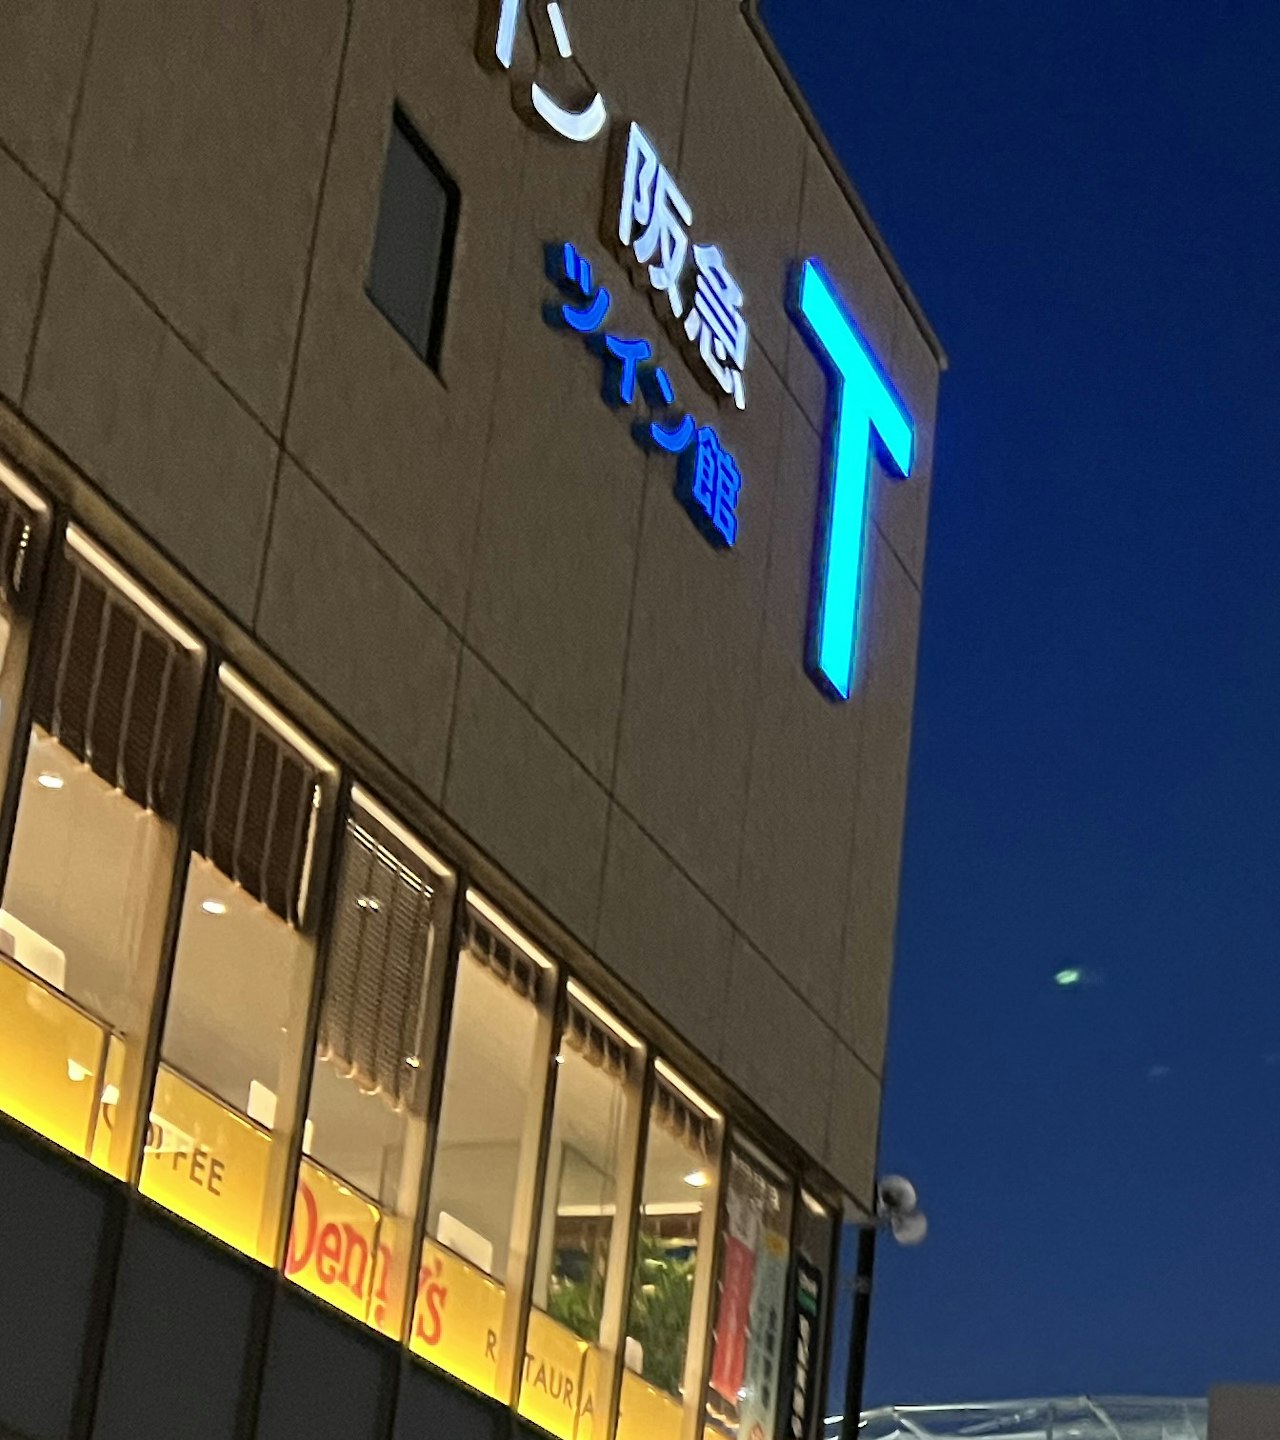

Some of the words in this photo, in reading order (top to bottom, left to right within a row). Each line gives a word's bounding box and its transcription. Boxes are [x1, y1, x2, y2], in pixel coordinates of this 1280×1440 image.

[562, 242, 741, 547] ツイン館
[799, 257, 915, 701] T
